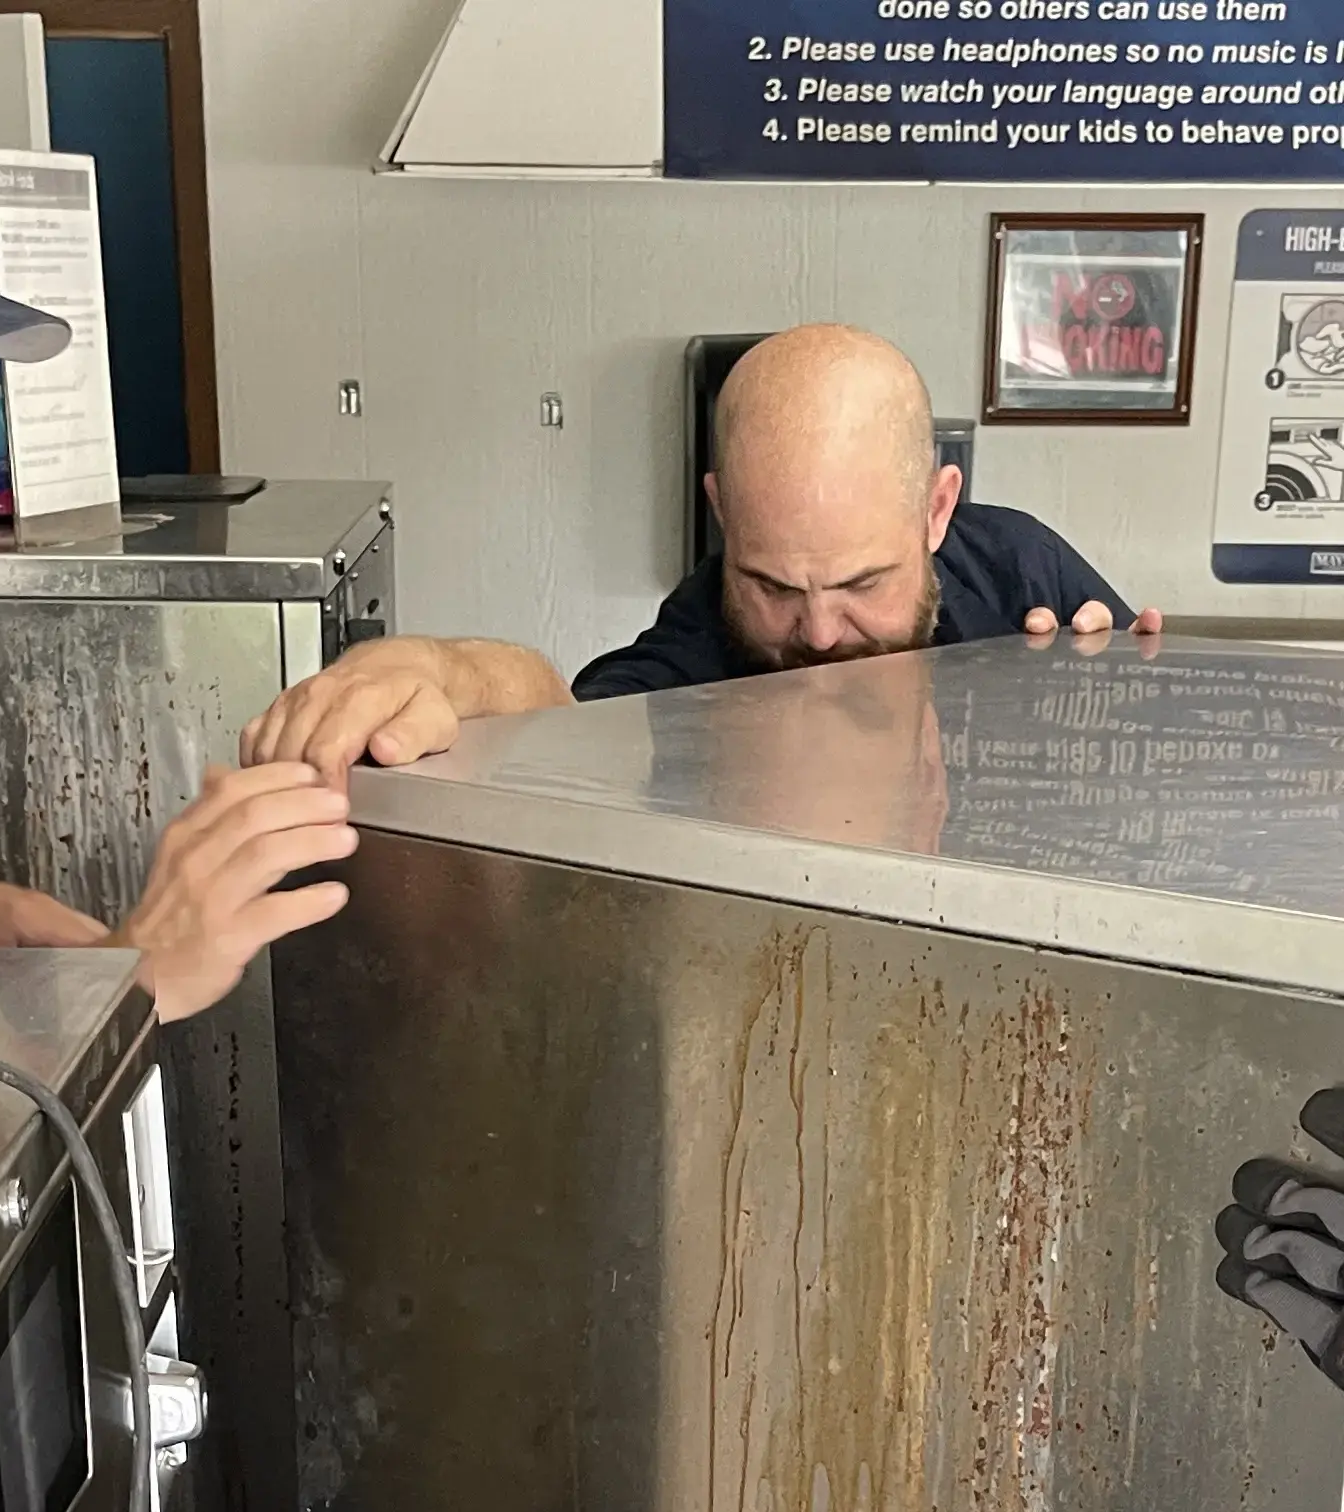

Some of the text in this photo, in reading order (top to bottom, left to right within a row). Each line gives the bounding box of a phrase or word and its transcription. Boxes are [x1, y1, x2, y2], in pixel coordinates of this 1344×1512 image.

[878, 0, 1287, 21] done so others can use them
[748, 36, 772, 61] 2.
[782, 36, 876, 62] Please
[884, 42, 935, 62] use
[943, 37, 1118, 68] headphones
[1125, 44, 1160, 63] so
[1167, 44, 1204, 64] no
[1211, 39, 1296, 64] music
[1304, 39, 1328, 64] is
[763, 78, 788, 102] 3.
[798, 77, 892, 102] Please
[900, 78, 984, 103] watch
[991, 82, 1057, 109] your
[1063, 79, 1194, 110] language
[1200, 80, 1303, 104] around
[762, 118, 788, 141] 4.
[797, 117, 892, 143] Please
[900, 119, 998, 143] remind
[1006, 123, 1071, 149] your
[1078, 119, 1138, 143] kids
[1145, 120, 1174, 143] to
[1182, 119, 1284, 144] behave
